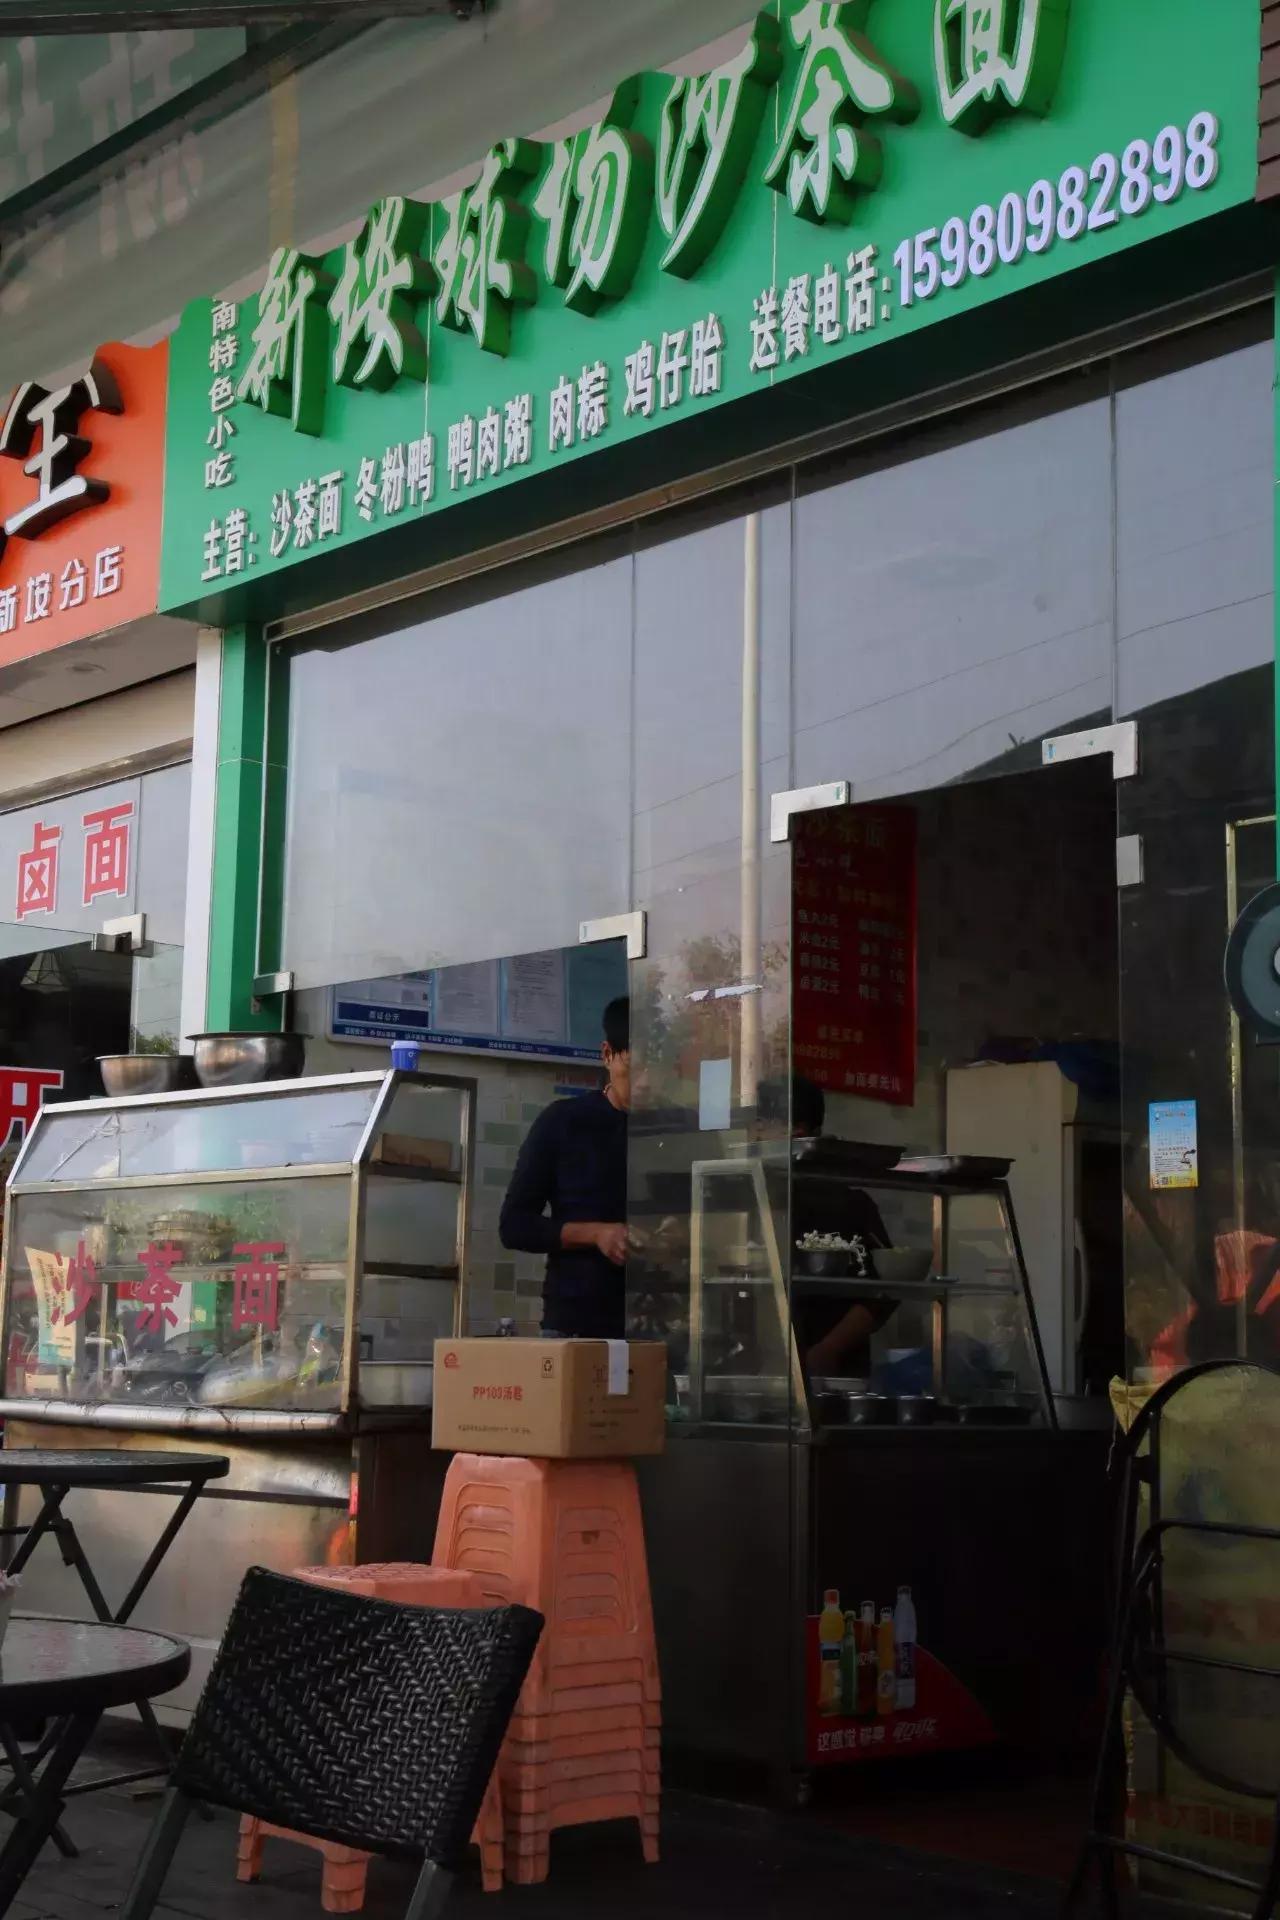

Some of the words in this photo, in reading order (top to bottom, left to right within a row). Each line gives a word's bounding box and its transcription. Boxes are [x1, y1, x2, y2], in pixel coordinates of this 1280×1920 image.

[201, 508, 257, 582] 主营:
[270, 469, 345, 558] 沙茶面
[354, 431, 435, 522] 冬粉鸭
[448, 394, 534, 490] 鸭肉粥
[549, 360, 610, 453] 肉粽
[623, 312, 725, 418] 鸡仔胎
[16, 800, 135, 921] 卤面
